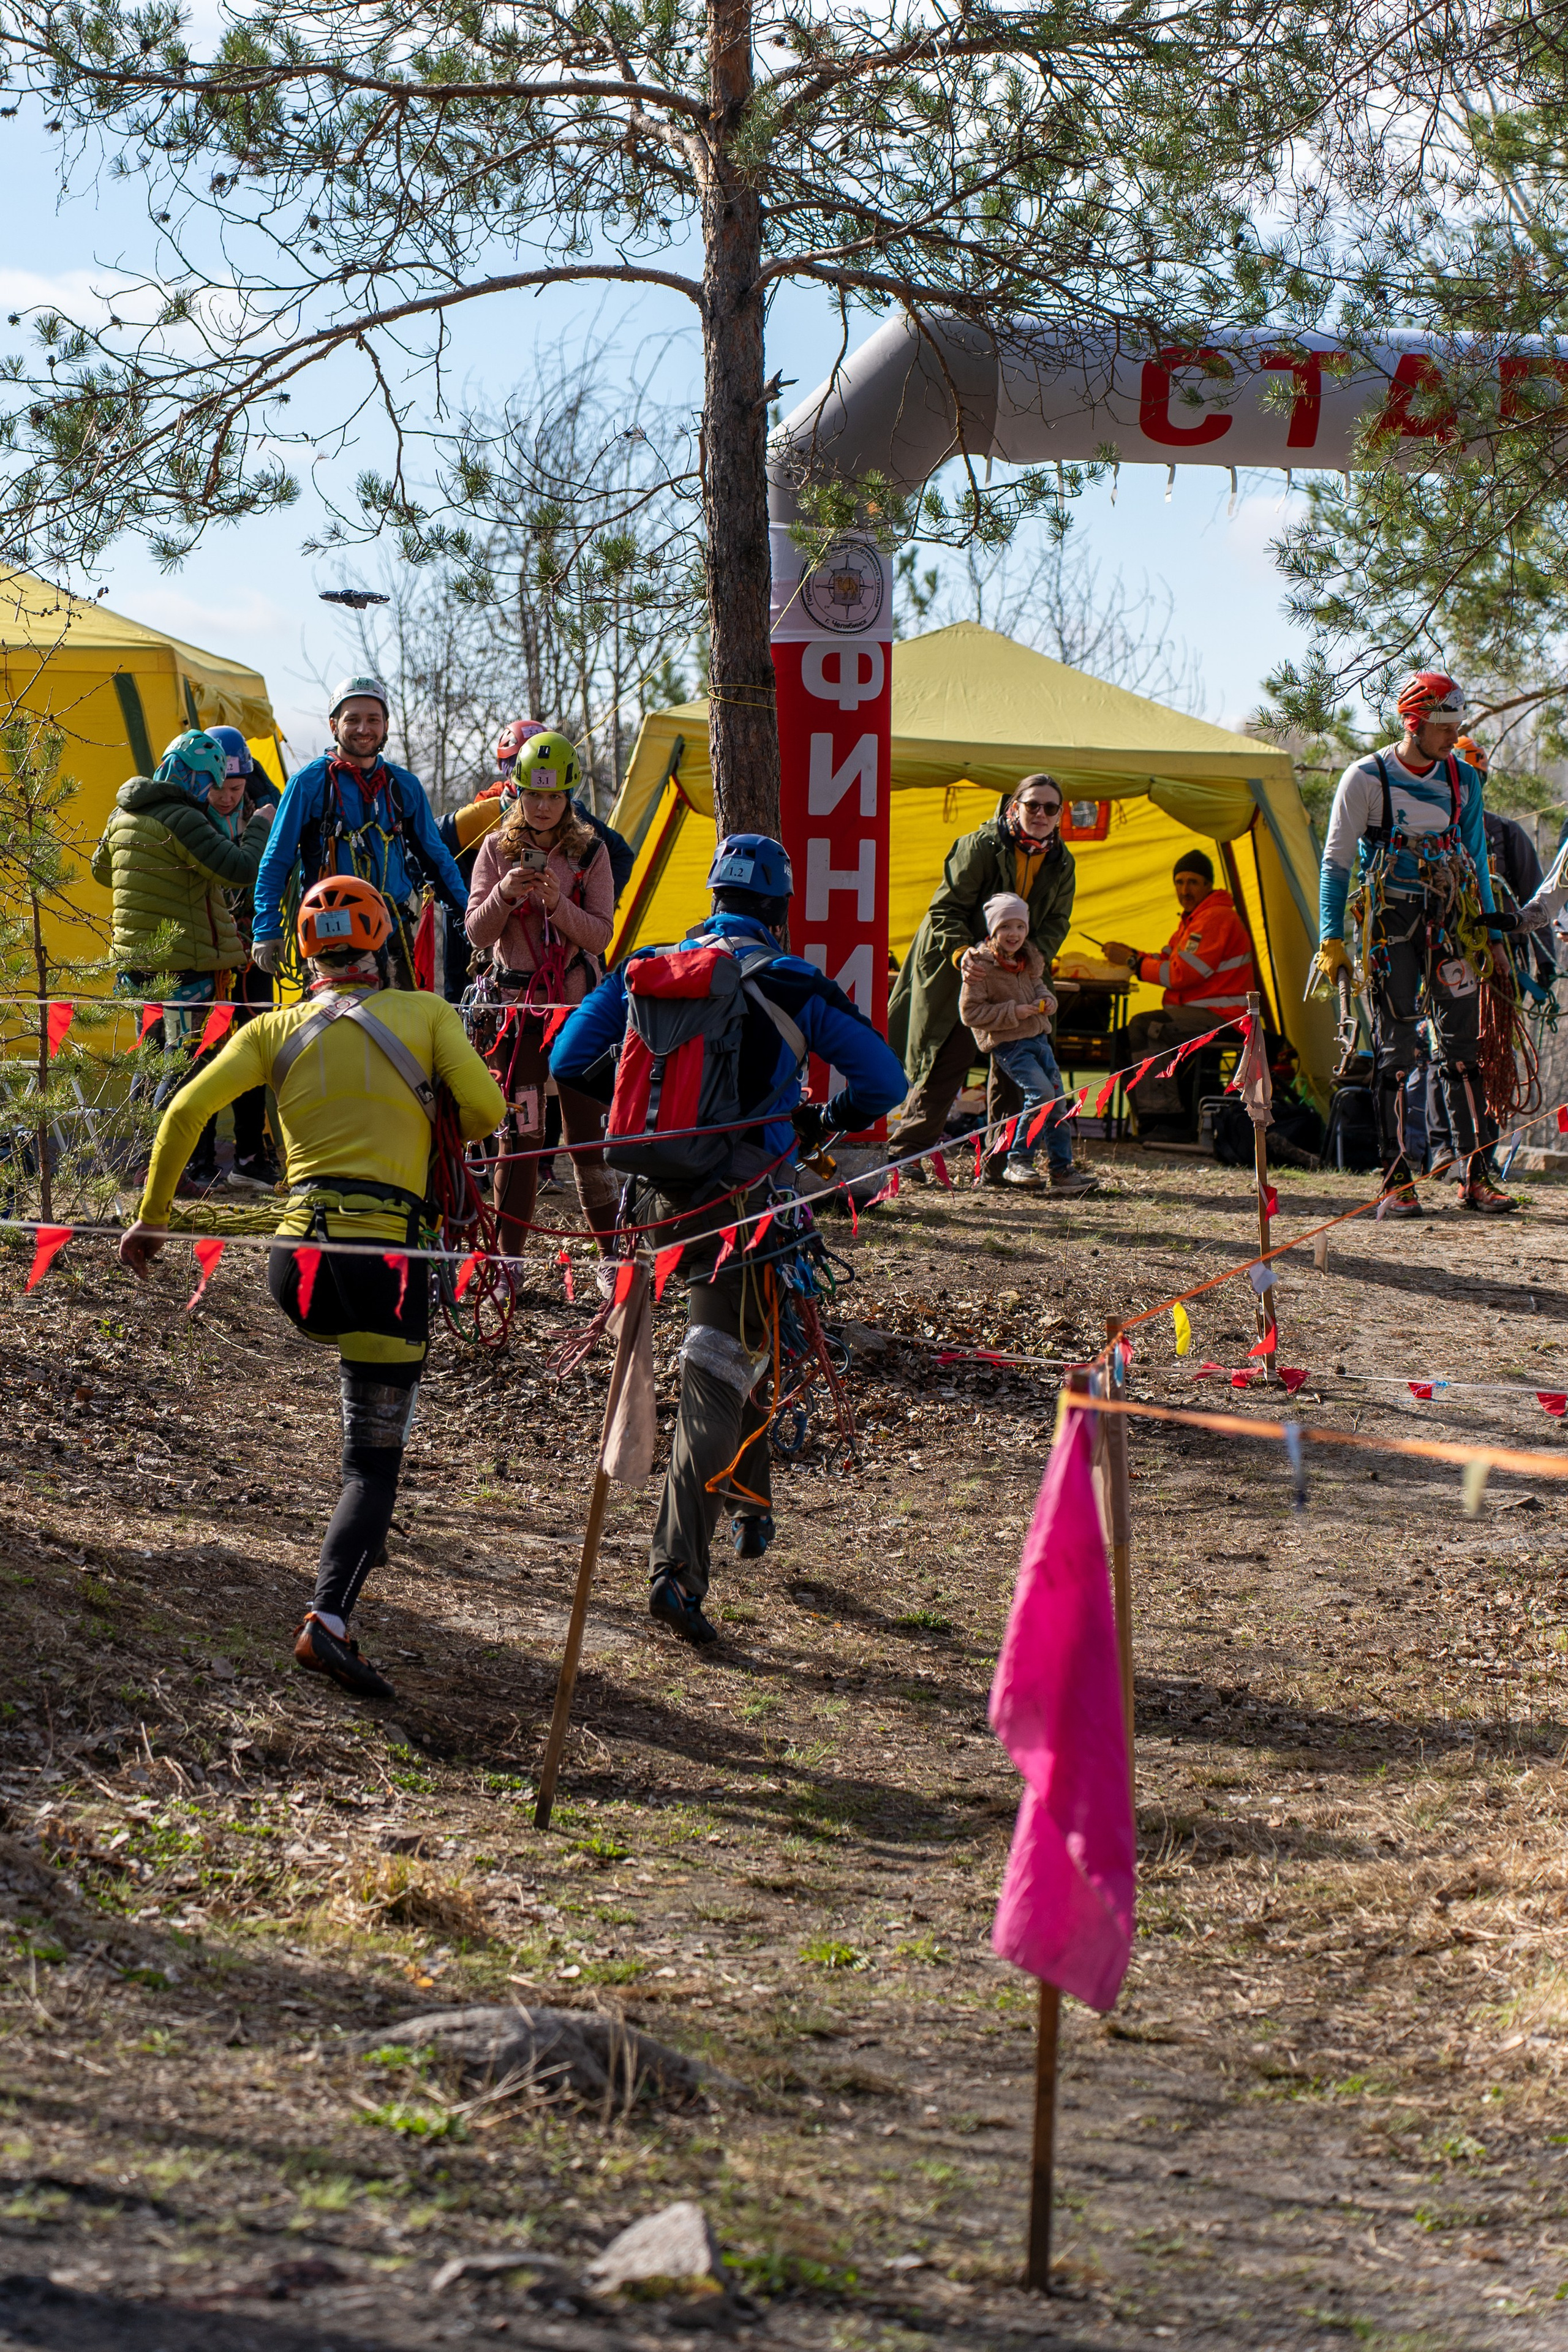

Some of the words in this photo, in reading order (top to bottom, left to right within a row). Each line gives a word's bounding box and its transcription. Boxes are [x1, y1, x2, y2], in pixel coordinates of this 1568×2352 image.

[832, 619, 867, 629] Челябинск
[729, 867, 744, 877] 1.2
[325, 921, 341, 932] 1.1
